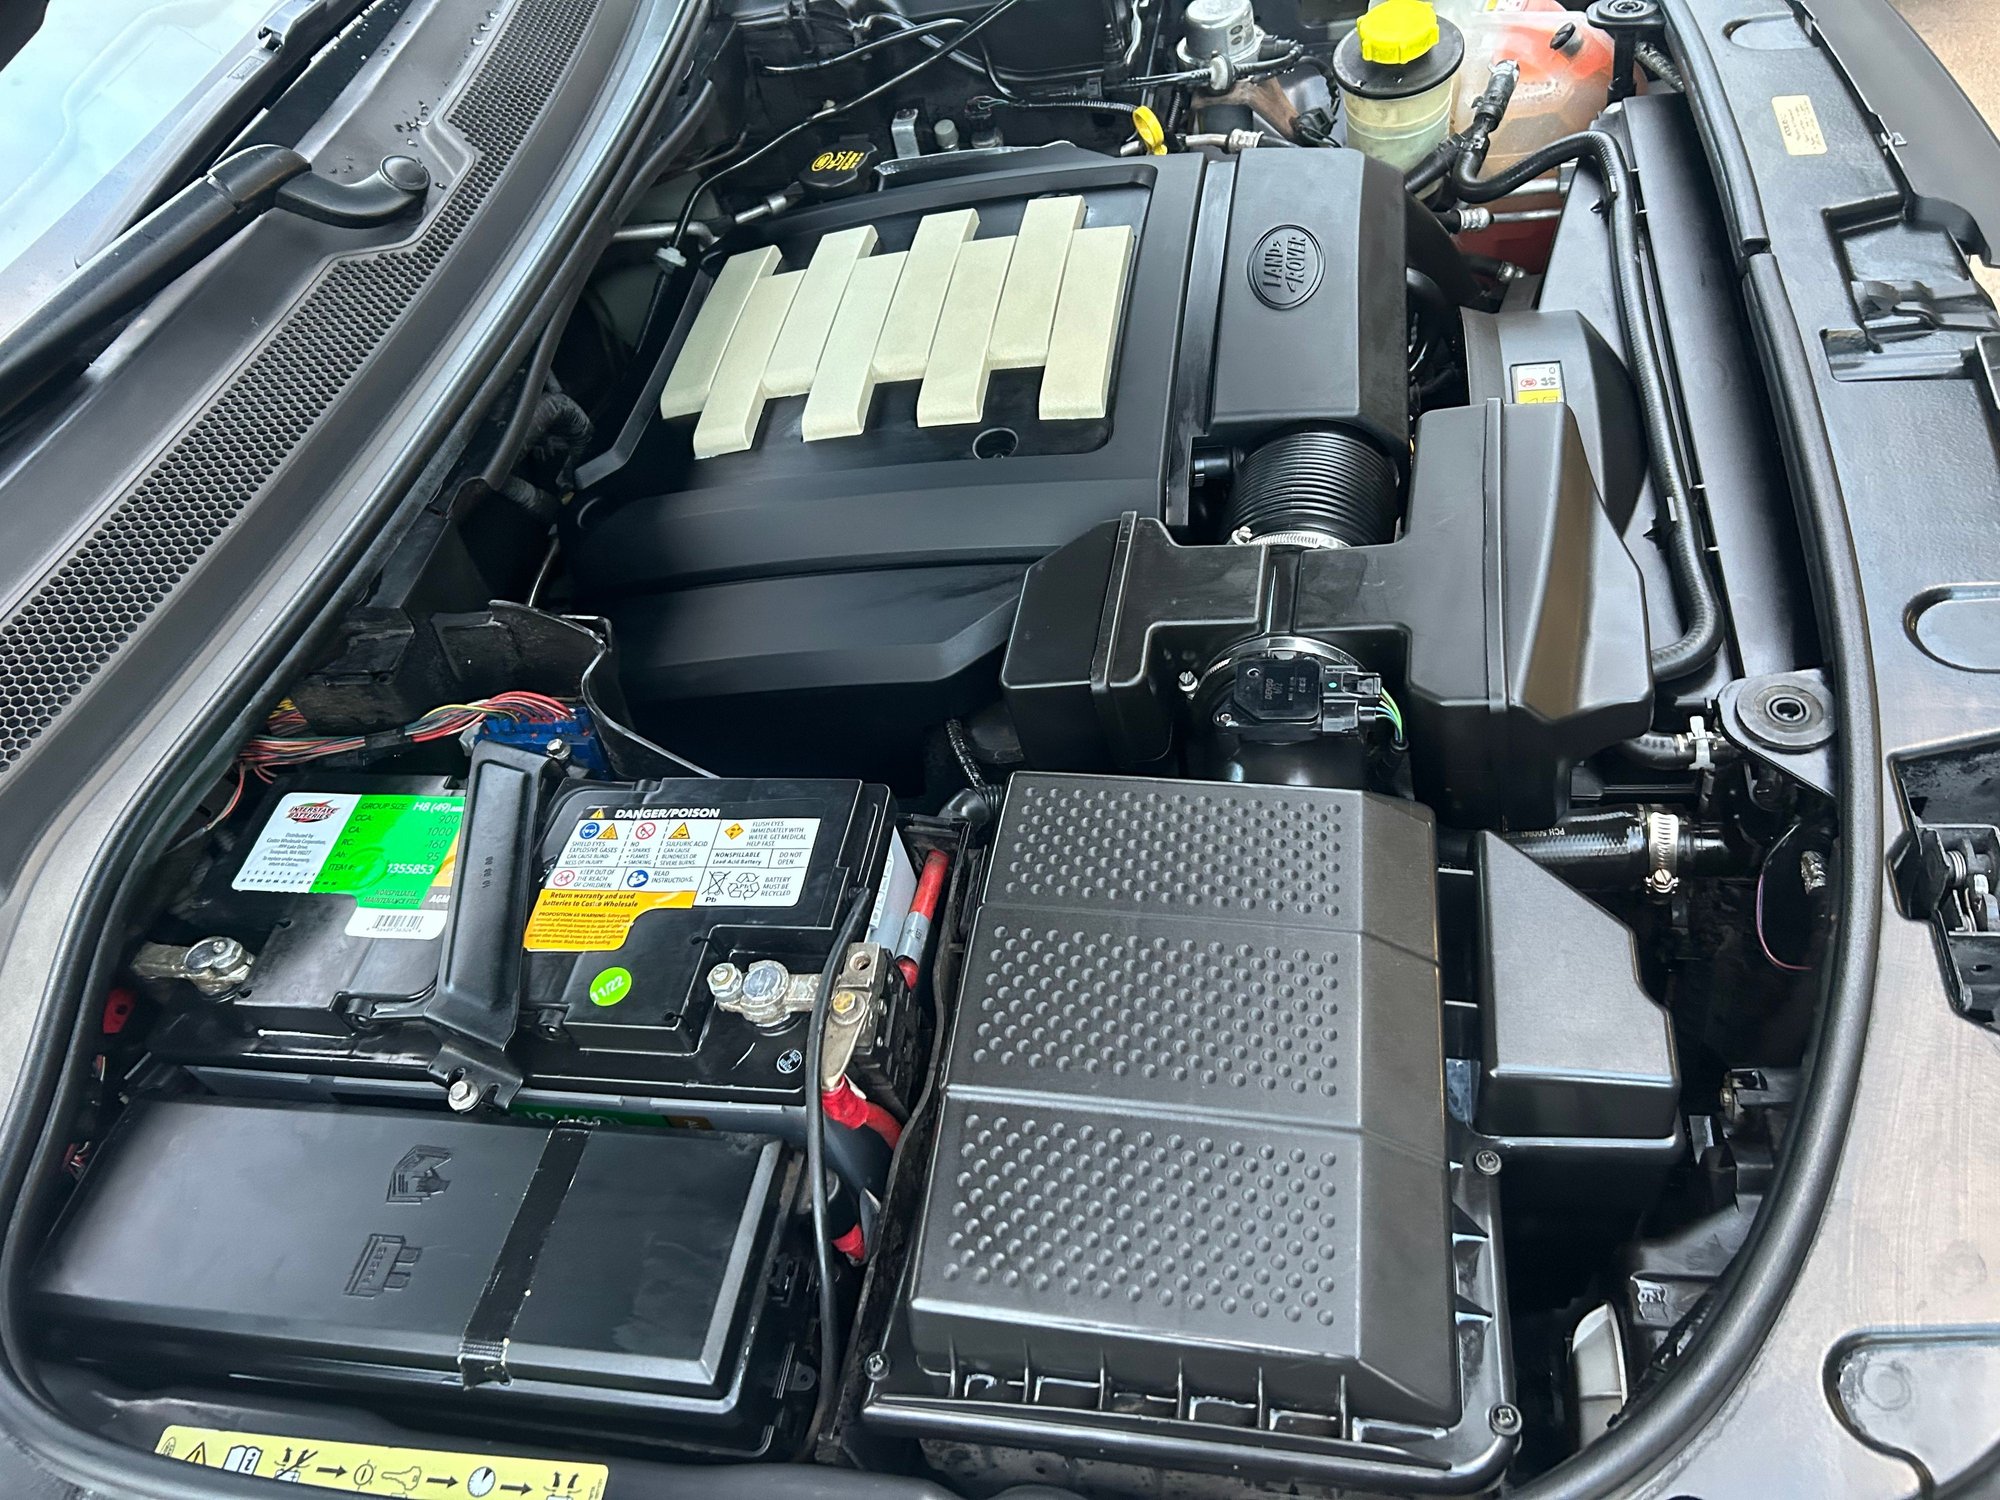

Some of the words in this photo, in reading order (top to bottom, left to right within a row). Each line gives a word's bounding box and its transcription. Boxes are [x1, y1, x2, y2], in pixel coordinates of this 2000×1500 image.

[1285, 236, 1306, 284] ROVER
[1262, 249, 1283, 288] LAND
[289, 805, 337, 815] INTERSTATE
[361, 802, 390, 810] GROUP
[412, 801, 430, 811] H8
[429, 801, 451, 813] (49)
[287, 812, 331, 820] BATTERIES
[354, 814, 373, 822] CCA:
[614, 807, 720, 819] DANGER/POISON
[439, 814, 460, 824] 900
[428, 827, 453, 837] 1000
[1548, 827, 1566, 836] PCH
[426, 852, 440, 861] 95
[328, 863, 347, 871] ITEM
[386, 862, 435, 875] 1355853
[428, 894, 451, 904] AGM
[573, 893, 603, 901] warranty
[603, 900, 638, 908] Wholesale
[591, 975, 625, 1001] 11/22
